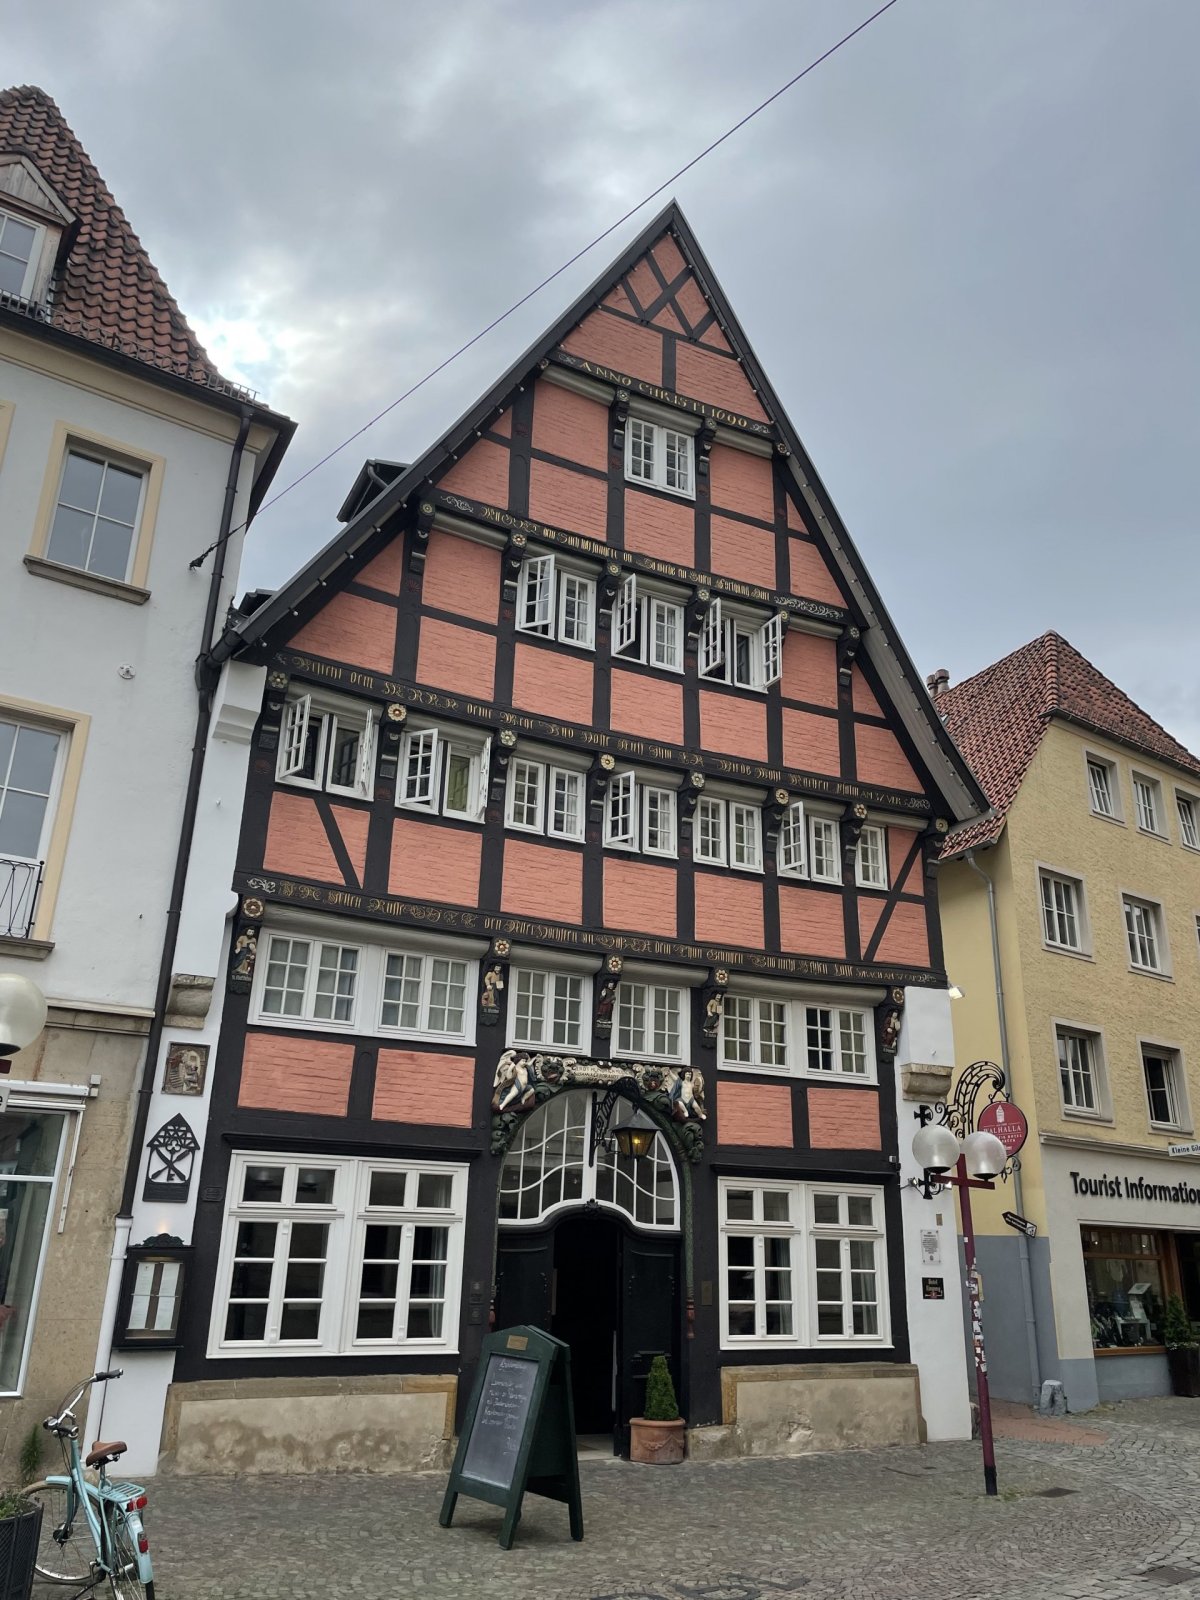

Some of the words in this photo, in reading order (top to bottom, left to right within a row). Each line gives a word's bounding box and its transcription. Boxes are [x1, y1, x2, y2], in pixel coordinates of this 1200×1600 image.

[579, 358, 631, 387] ANNO
[638, 380, 705, 414] CHRISTI
[711, 407, 747, 430] 1690
[984, 1125, 1021, 1134] WALHALLA
[1171, 1146, 1190, 1154] Kleine
[1070, 1171, 1123, 1198] Tourist
